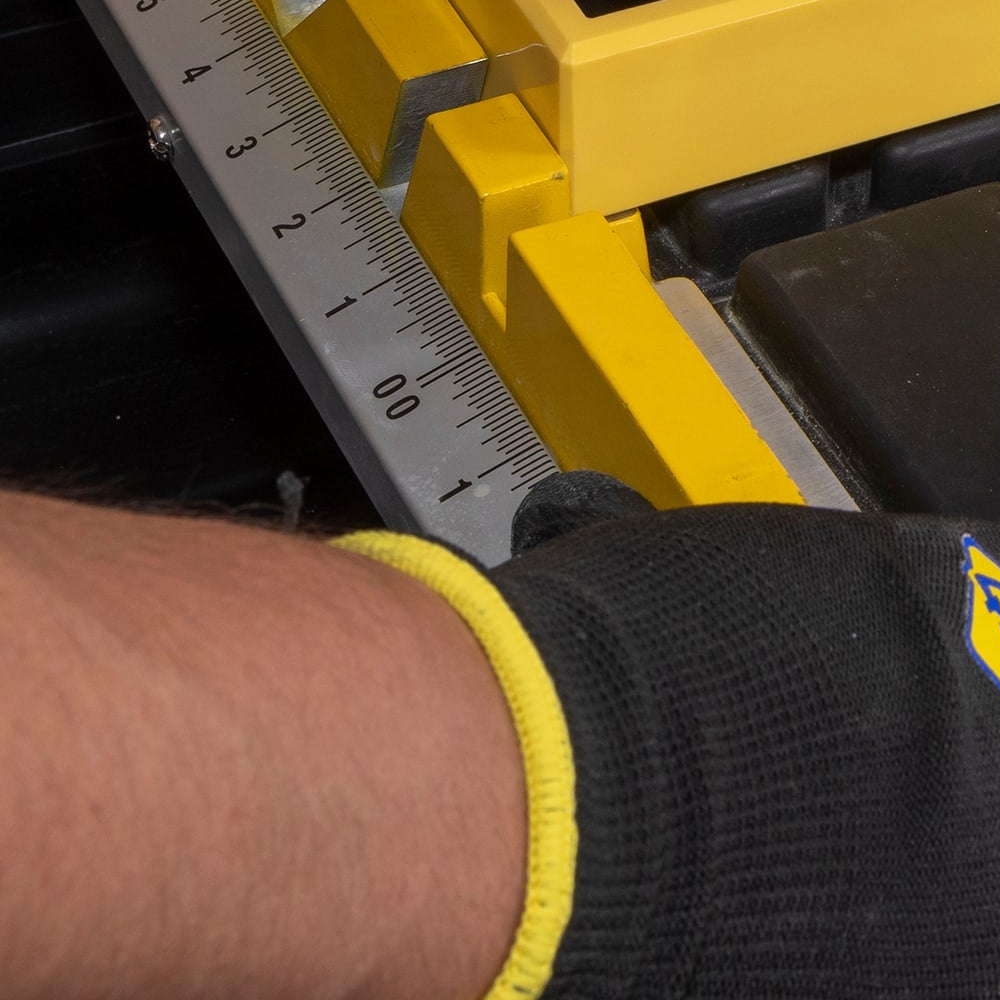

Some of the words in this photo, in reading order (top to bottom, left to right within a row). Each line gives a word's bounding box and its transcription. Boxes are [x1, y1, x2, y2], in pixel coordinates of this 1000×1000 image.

[182, 64, 212, 85] 4
[225, 135, 258, 159] 3
[272, 213, 306, 239] 2
[325, 295, 358, 318] 1
[439, 478, 473, 503] 1
